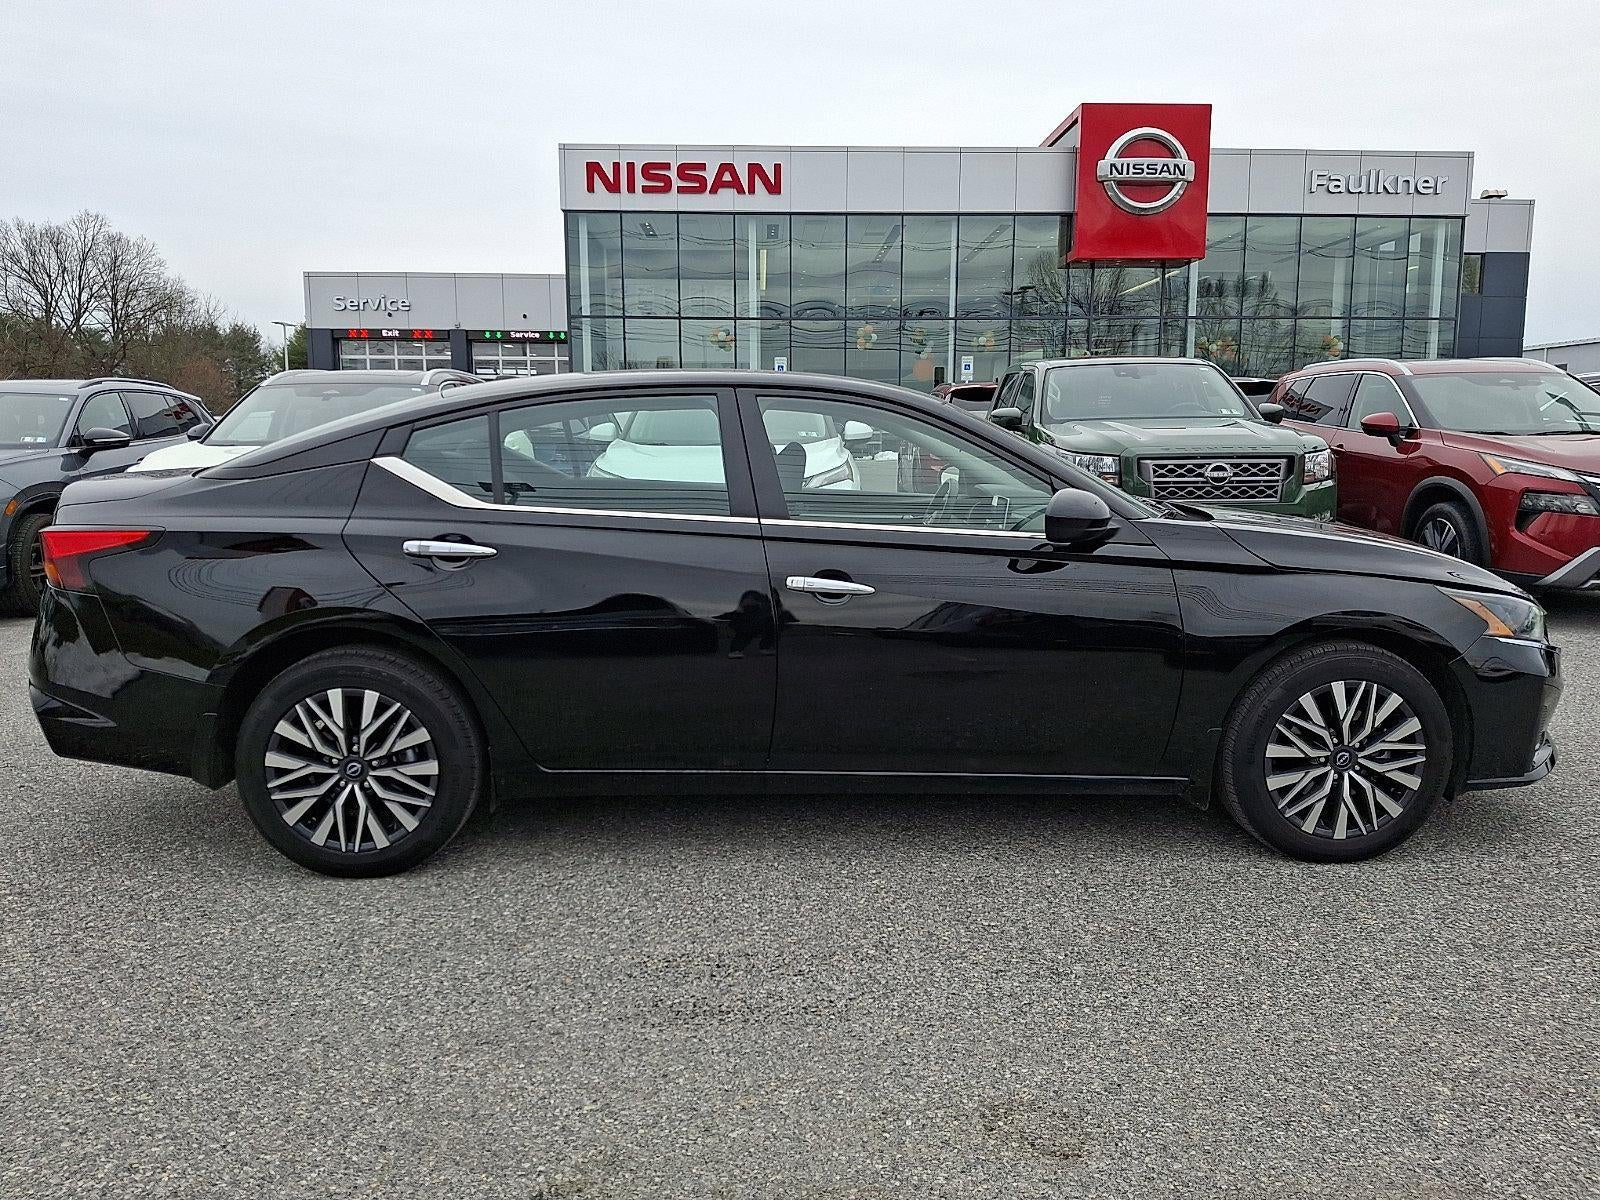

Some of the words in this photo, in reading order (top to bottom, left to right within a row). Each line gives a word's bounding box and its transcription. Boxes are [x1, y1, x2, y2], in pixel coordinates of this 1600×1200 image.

[1109, 162, 1187, 177] NISSAN
[586, 162, 783, 195] NISSAN
[1309, 169, 1449, 195] Faulkner
[332, 294, 411, 312] Service
[381, 329, 400, 337] Exit
[510, 331, 540, 339] Service
